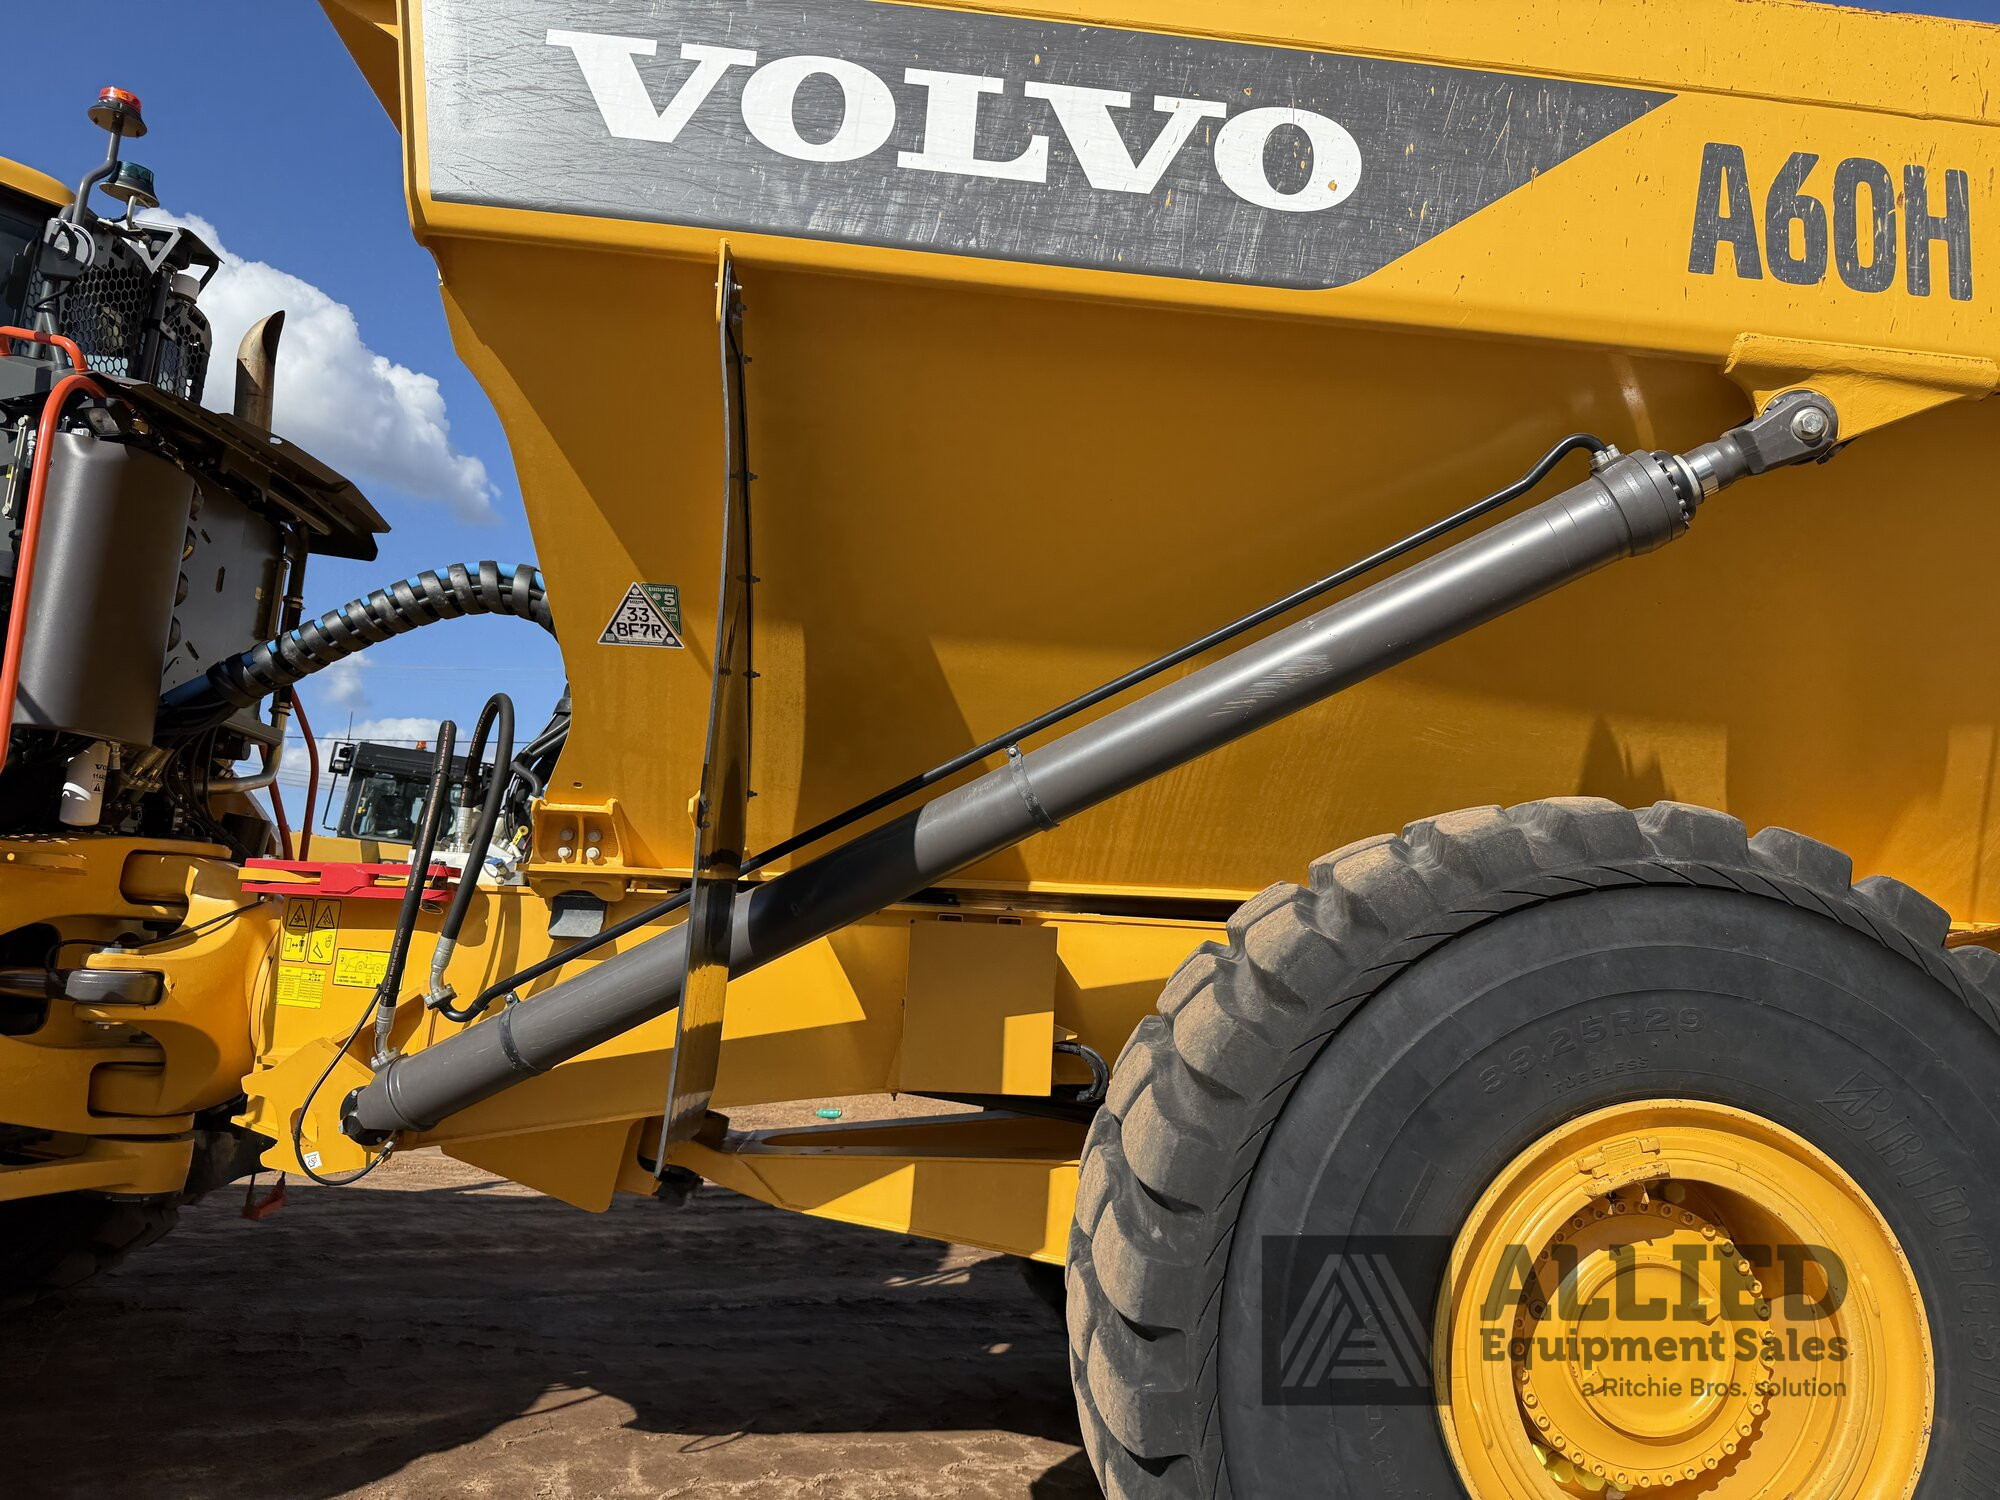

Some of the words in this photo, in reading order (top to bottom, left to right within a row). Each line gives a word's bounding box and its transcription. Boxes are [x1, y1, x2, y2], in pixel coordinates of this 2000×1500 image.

[546, 29, 1362, 212] VOLVO
[1688, 142, 1973, 301] A60H
[616, 622, 662, 638] BF7R
[627, 606, 649, 622] 33
[664, 594, 675, 606] 5
[1816, 1070, 2000, 1500] BRIDGESTON
